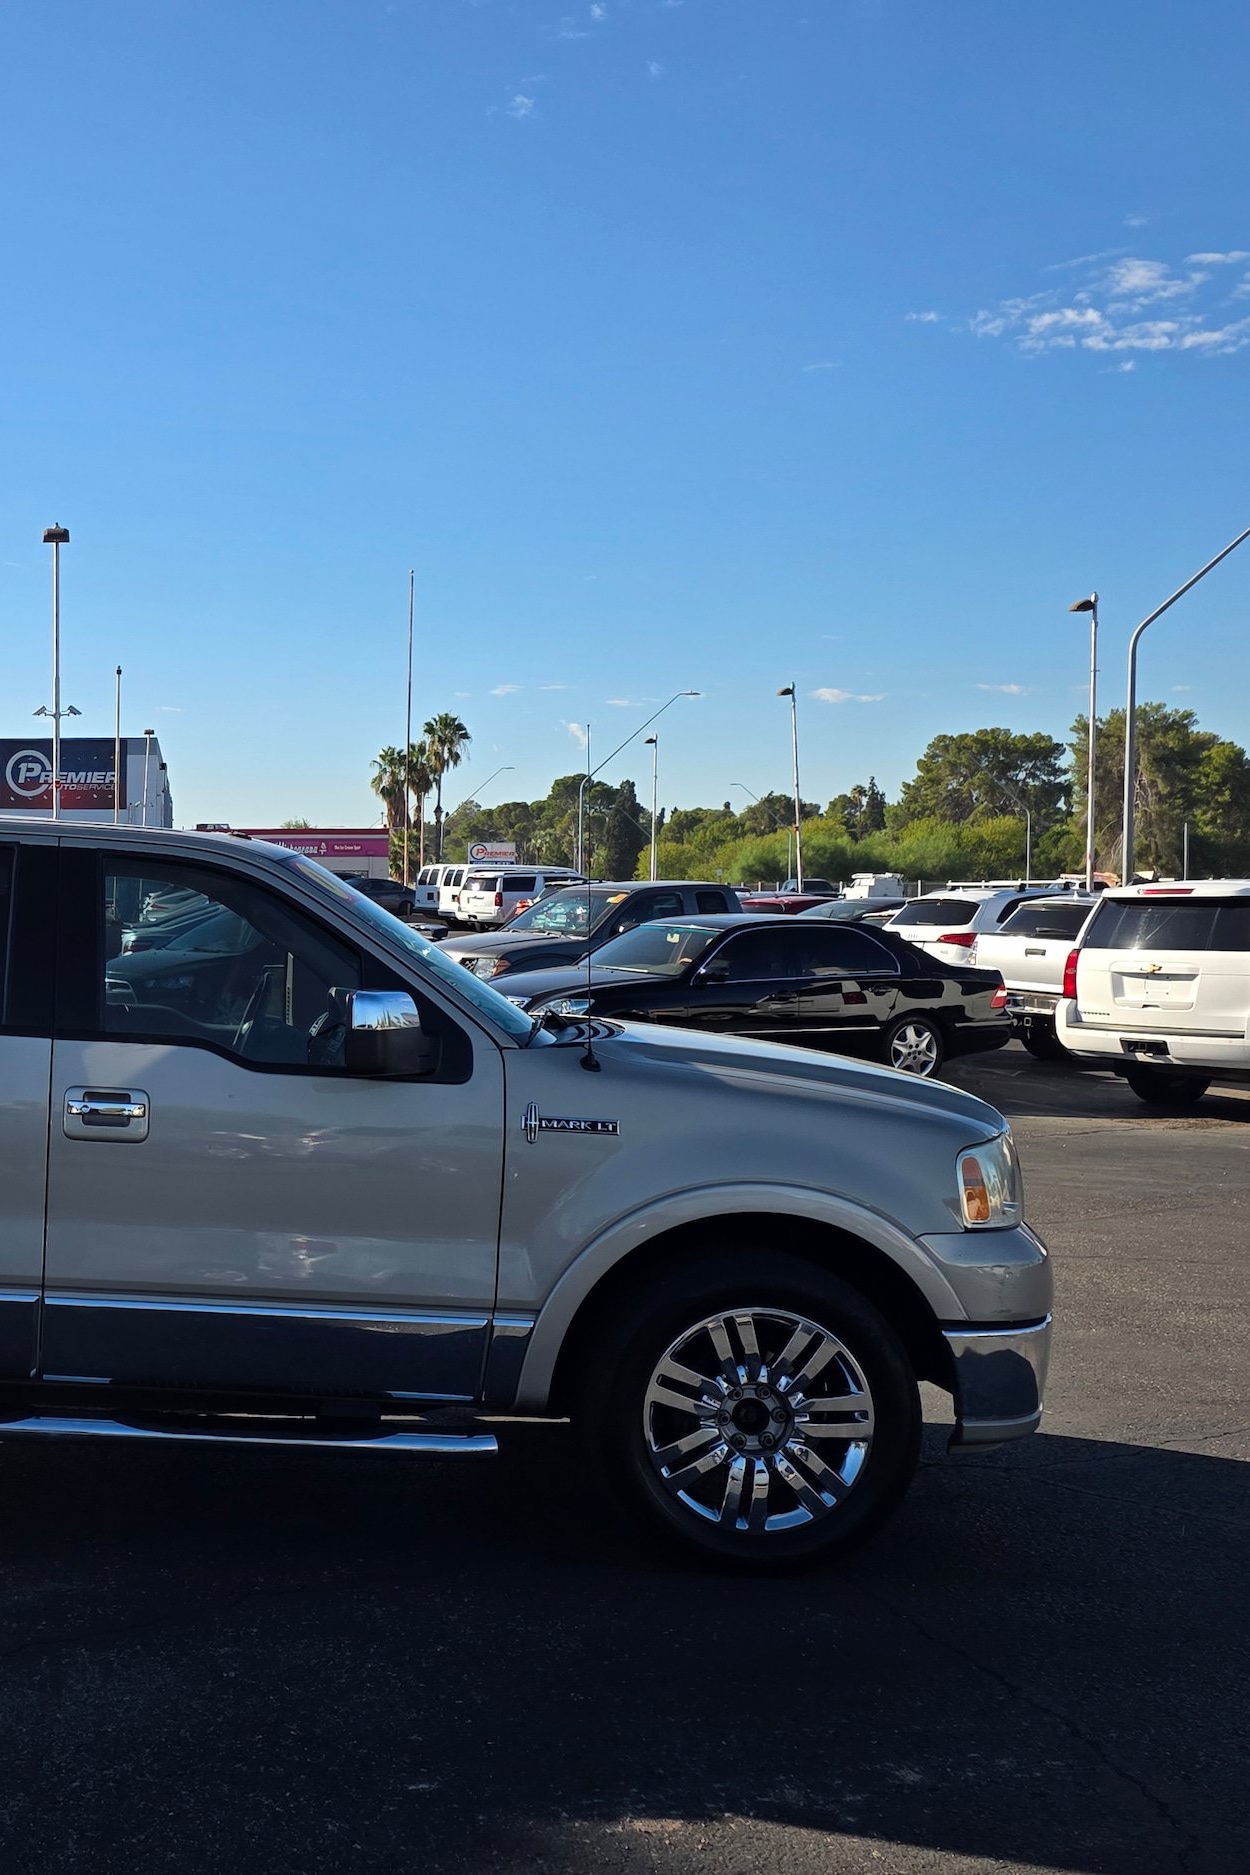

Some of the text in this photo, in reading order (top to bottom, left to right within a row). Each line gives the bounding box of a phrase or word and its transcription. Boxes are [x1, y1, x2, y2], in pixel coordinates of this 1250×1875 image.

[18, 763, 118, 784] PREMIER
[476, 848, 515, 857] PREMIER
[541, 1120, 617, 1131] MARK LT
